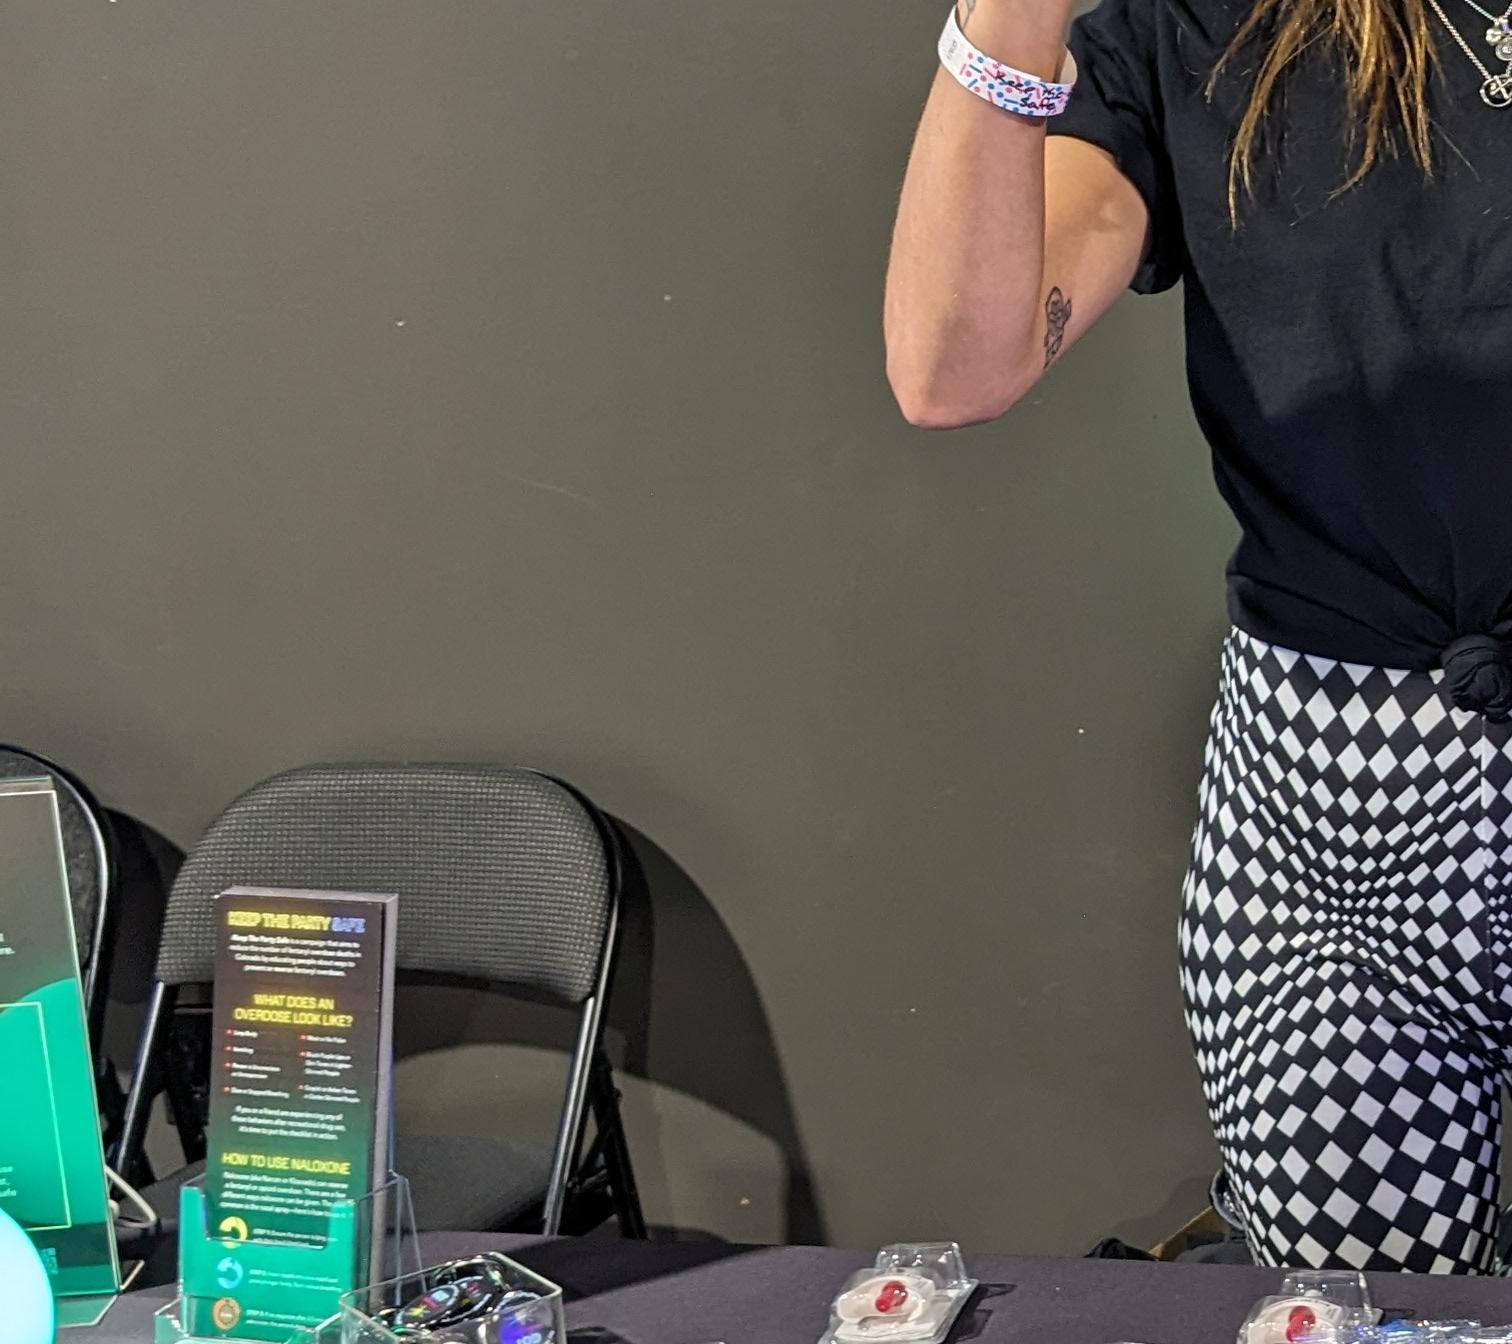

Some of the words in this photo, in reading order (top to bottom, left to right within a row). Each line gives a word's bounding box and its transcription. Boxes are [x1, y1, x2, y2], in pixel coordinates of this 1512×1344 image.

[263, 912, 290, 929] THE
[291, 914, 331, 931] PARTY
[253, 994, 286, 1006] WHAT
[287, 996, 316, 1009] DOES
[318, 997, 335, 1010] AN
[233, 1008, 292, 1024] OVERDOSE
[293, 1011, 323, 1025] LOOK
[324, 1012, 353, 1027] LIKE?
[222, 1152, 249, 1166] HOW
[250, 1155, 265, 1167] TO
[266, 1156, 289, 1169] USE
[290, 1158, 352, 1175] NALOXONE
